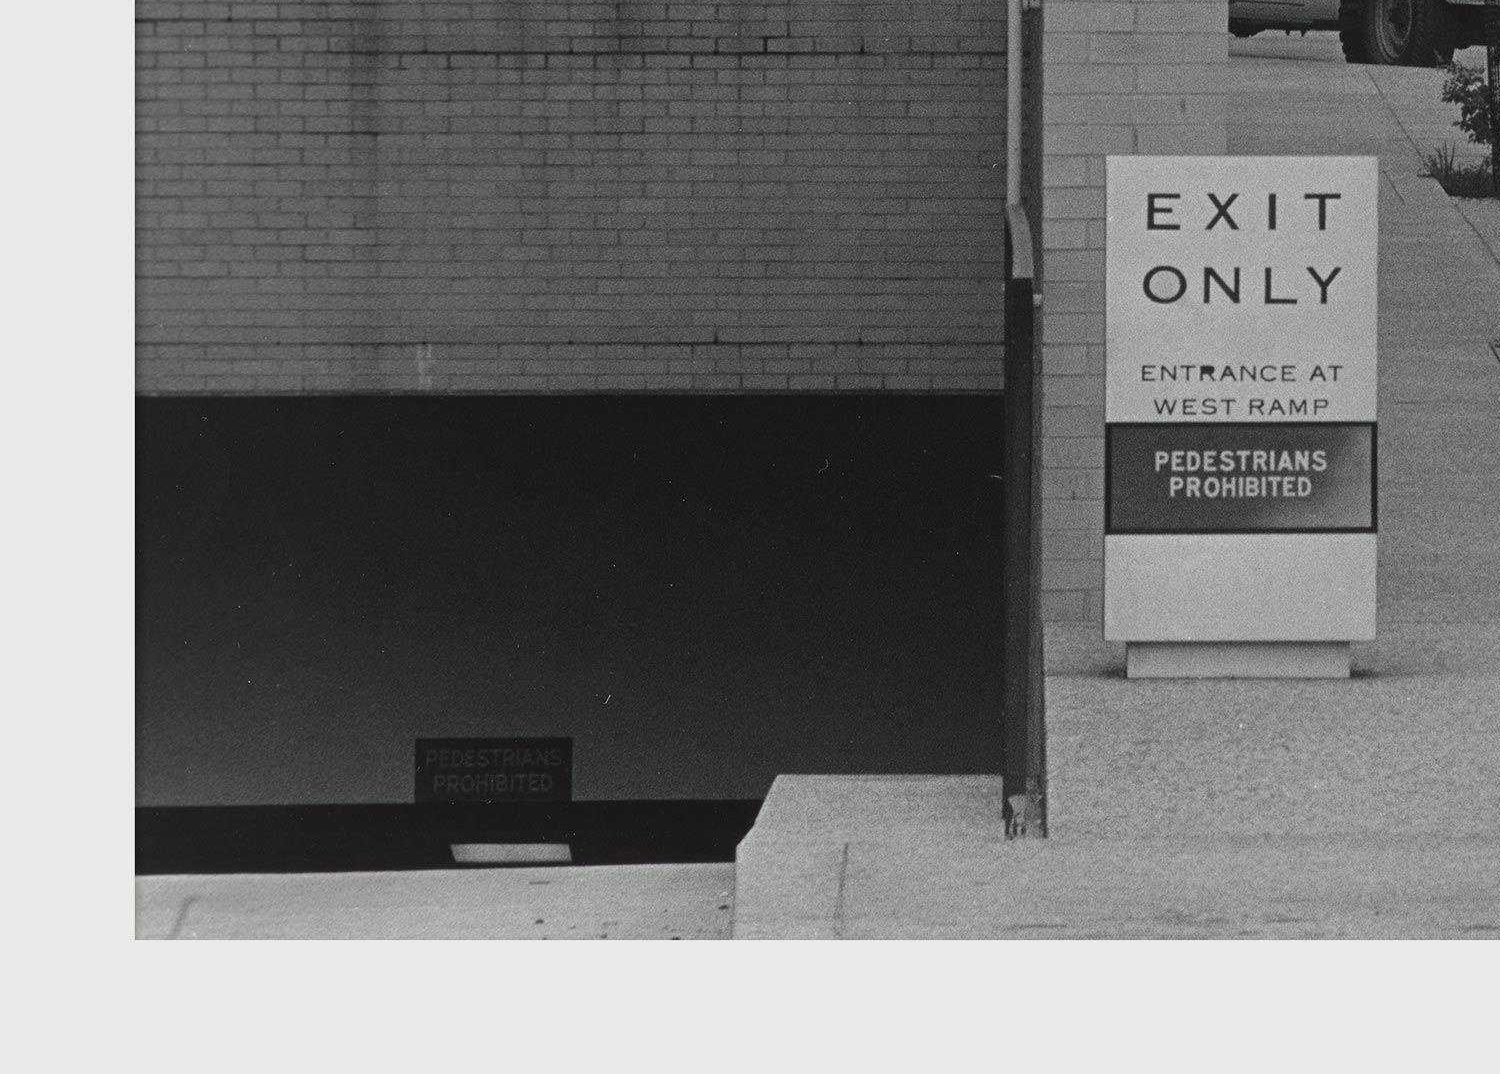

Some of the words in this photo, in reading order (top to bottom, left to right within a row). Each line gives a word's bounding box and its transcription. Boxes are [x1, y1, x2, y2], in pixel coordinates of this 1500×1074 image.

[1147, 192, 1342, 231] EXIT
[1142, 265, 1343, 305] ONLY
[1141, 365, 1297, 382] ENTRANCE
[1309, 365, 1344, 382] AT
[1154, 399, 1236, 415] WEST
[1249, 399, 1330, 415] RAMP
[1155, 450, 1328, 473] PEDESTRIANS
[1169, 476, 1313, 498] PROHIBITED
[425, 748, 562, 768] PEDESTRIANS
[432, 774, 553, 793] PROHIBITED
